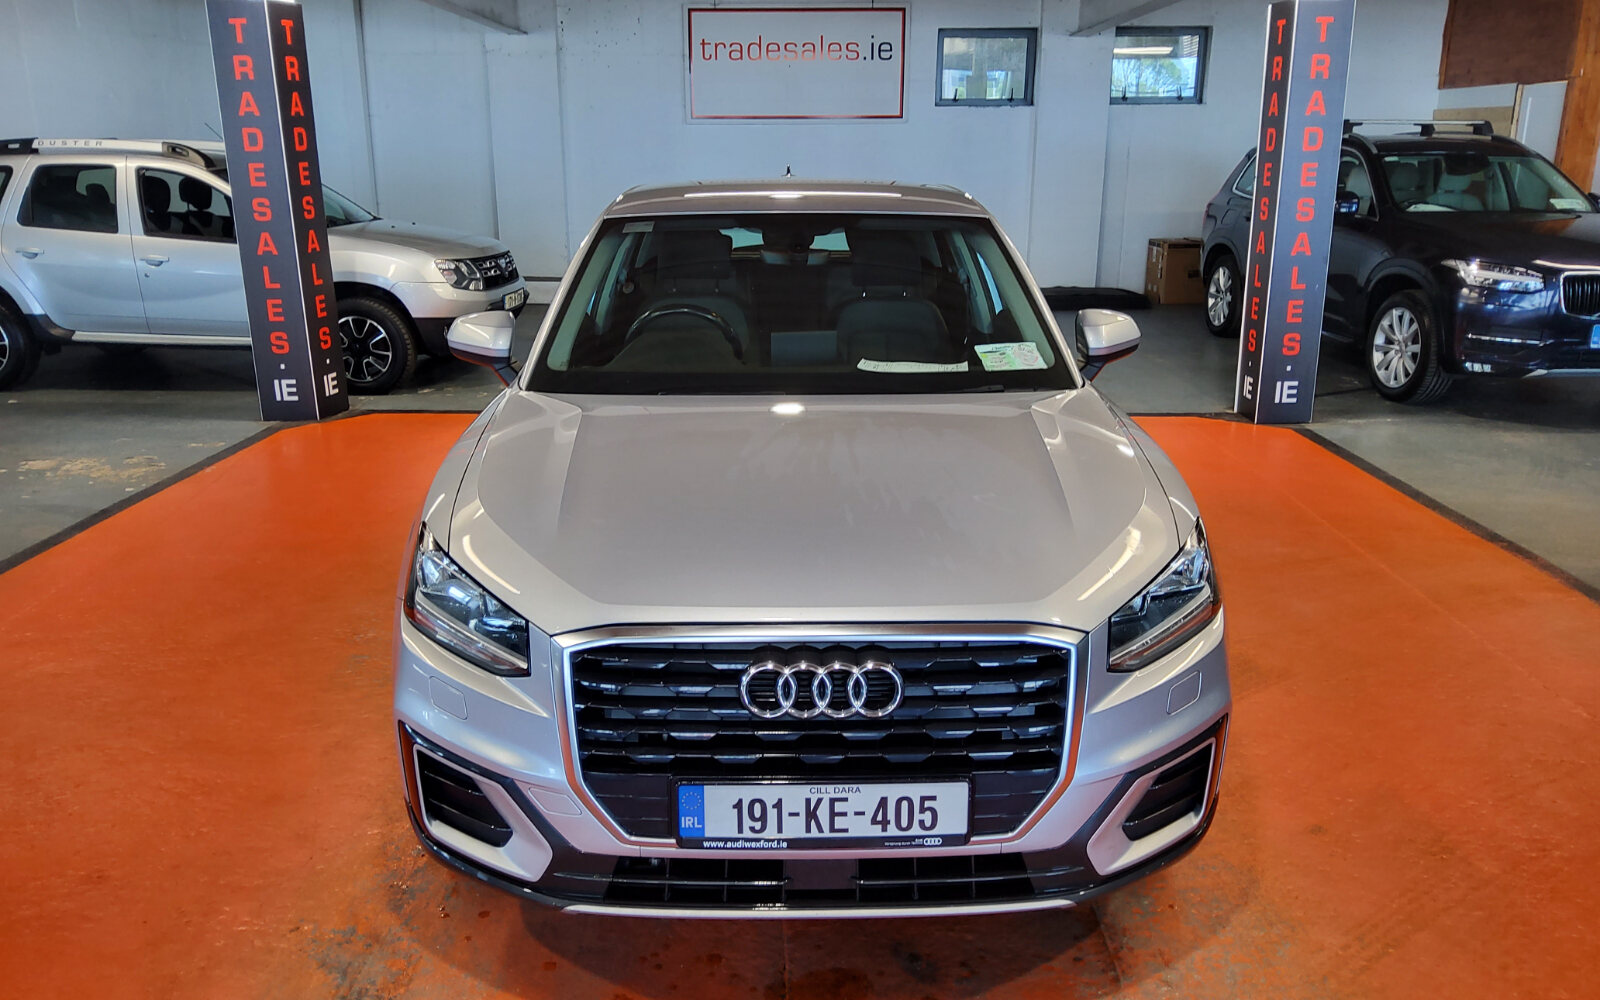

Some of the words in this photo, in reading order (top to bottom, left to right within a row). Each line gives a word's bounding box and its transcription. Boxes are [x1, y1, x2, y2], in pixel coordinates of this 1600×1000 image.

[699, 34, 893, 61] tradesales.ie
[833, 786, 861, 794] DARA
[732, 795, 939, 834] 191-KE-405
[681, 816, 702, 828] IRL
[702, 840, 788, 849] www.audiwexford.ie
